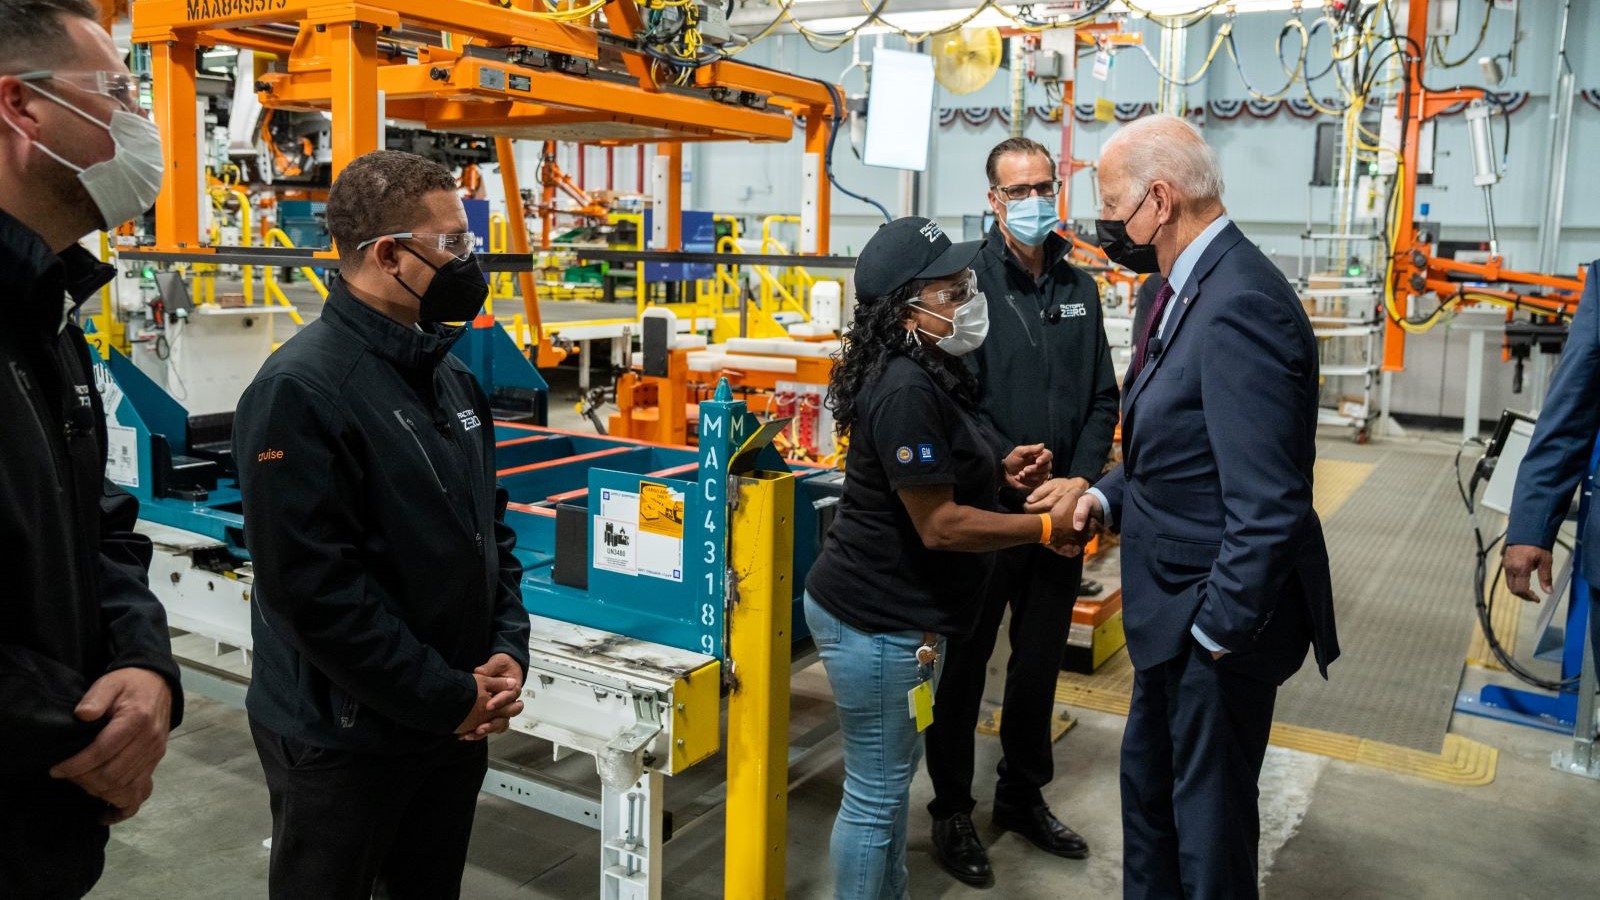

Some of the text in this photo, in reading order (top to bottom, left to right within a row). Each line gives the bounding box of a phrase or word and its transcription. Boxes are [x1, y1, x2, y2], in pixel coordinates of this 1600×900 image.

[1060, 307, 1087, 318] ZERO
[258, 448, 284, 462] cruise
[921, 447, 932, 458] GM
